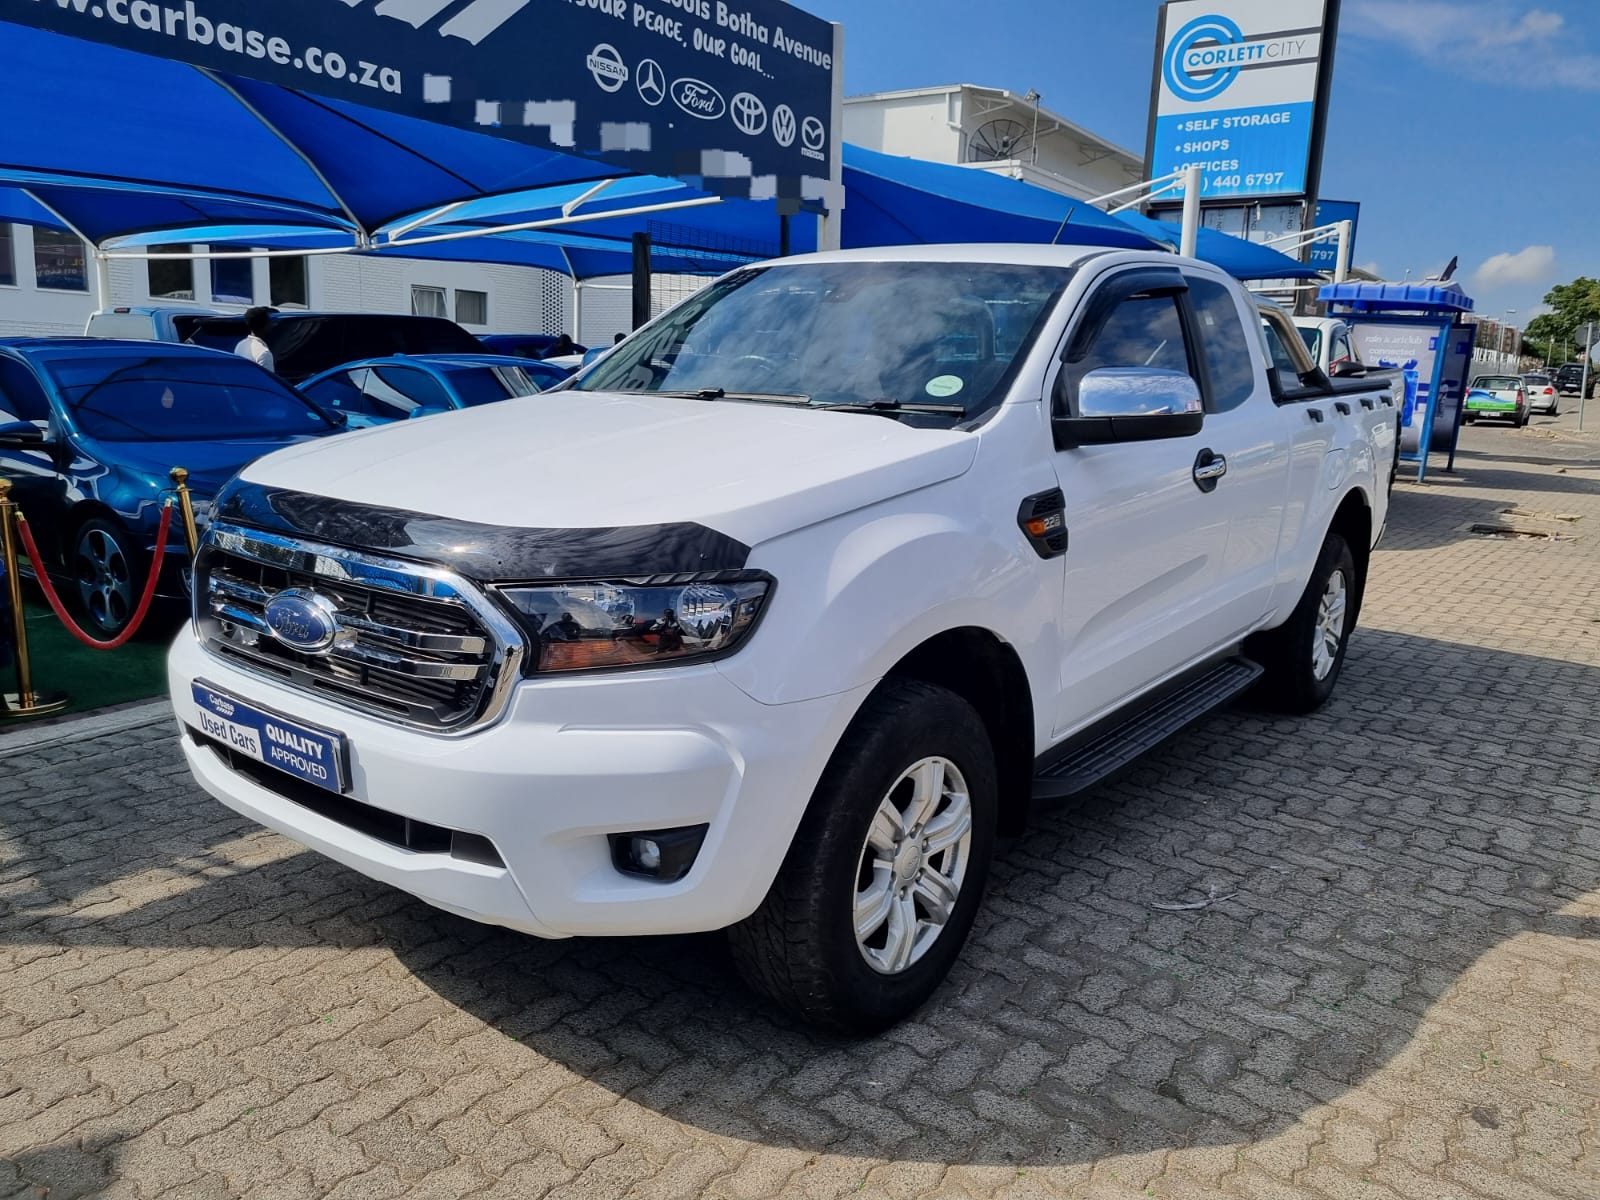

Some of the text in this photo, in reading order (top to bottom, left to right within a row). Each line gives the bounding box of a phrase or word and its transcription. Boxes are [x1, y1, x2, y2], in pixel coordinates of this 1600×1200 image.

[633, 3, 687, 48] PEACE,
[693, 28, 726, 58] OUR
[662, 0, 832, 70] uis Botha Avenue
[589, 58, 627, 78] NISSAN
[681, 83, 715, 114] Ford
[1185, 111, 1291, 132] SELF STORAGE
[1183, 139, 1230, 153] SHOPS
[1213, 175, 1240, 188] 440
[1245, 172, 1284, 186] 6797
[1311, 250, 1335, 260] 797
[275, 606, 310, 640] Ford
[199, 711, 257, 754] Used Cars
[266, 723, 323, 760] QUALITY
[271, 746, 327, 780] APPROVED
